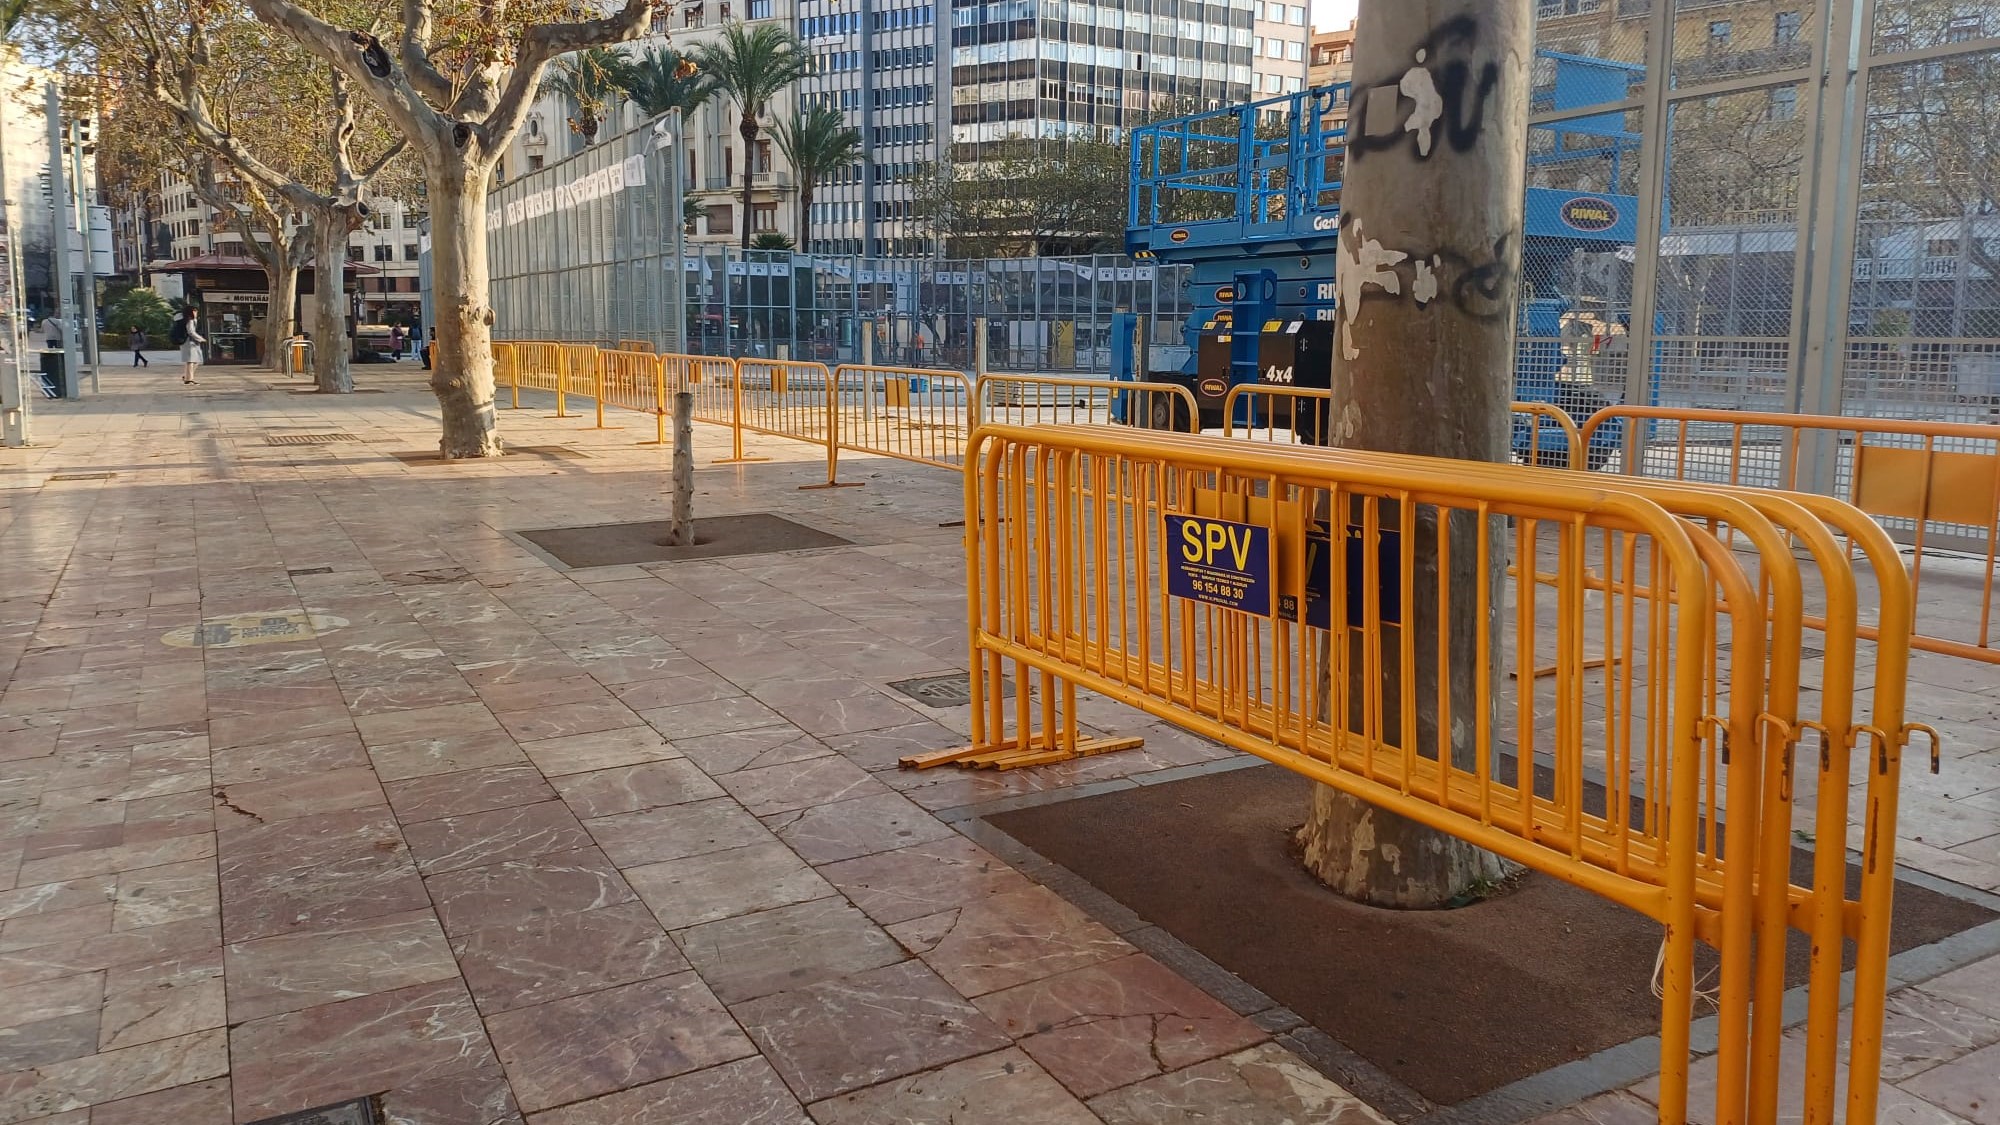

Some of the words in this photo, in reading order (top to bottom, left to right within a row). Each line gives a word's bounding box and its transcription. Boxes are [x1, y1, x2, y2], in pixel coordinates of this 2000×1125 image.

[1313, 214, 1339, 230] Geni
[1571, 208, 1609, 220] RIWAL
[1266, 365, 1293, 383] 4x4
[1182, 520, 1252, 571] SPV
[1192, 579, 1203, 591] 96
[1204, 582, 1218, 594] 154
[1220, 585, 1231, 597] 88
[1233, 587, 1244, 600] 30
